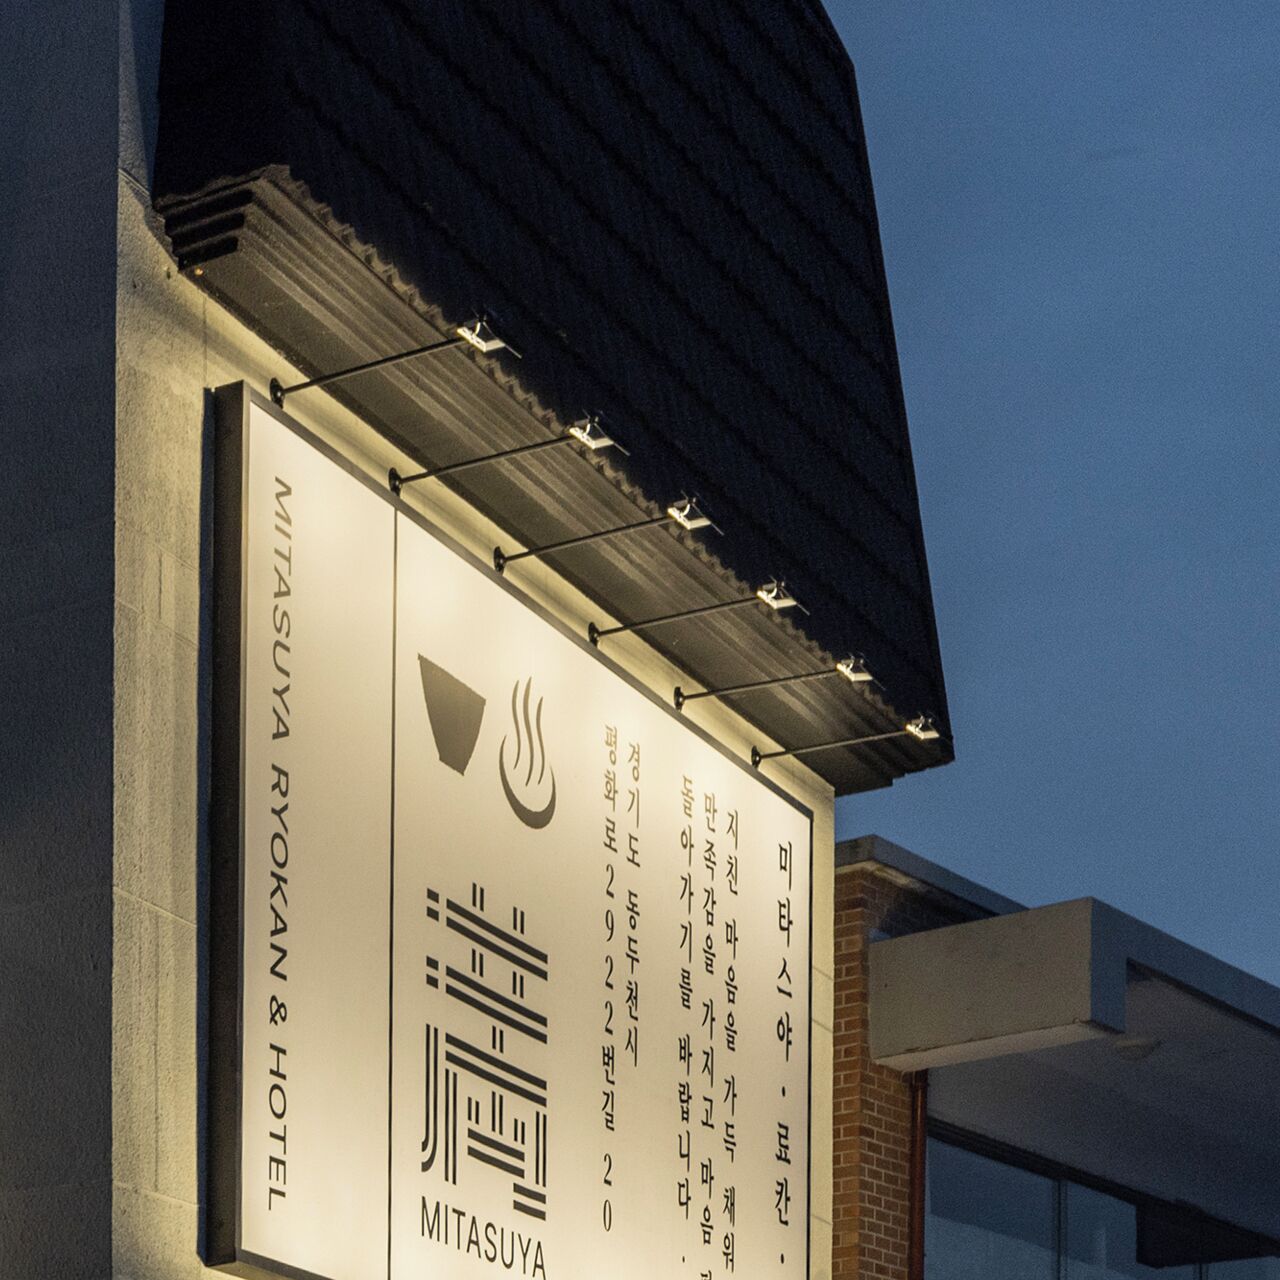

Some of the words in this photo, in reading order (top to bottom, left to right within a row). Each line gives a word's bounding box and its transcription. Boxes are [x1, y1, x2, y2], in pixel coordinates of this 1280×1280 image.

[271, 475, 293, 741] MITASUYA
[625, 743, 641, 868] 경기도
[725, 809, 739, 897] 지친
[269, 763, 290, 982] RYOKAN
[678, 775, 695, 1011] 돌아가기를
[702, 794, 718, 976] 만족감을
[269, 994, 288, 1027] &
[624, 889, 641, 1068] 동두천시
[723, 918, 739, 1053] 마음을
[268, 1042, 288, 1211] HOTEL
[700, 998, 716, 1130] 가지고
[722, 1074, 738, 1164] 가득
[602, 1153, 613, 1232] 20
[699, 1157, 715, 1245] 마음
[721, 1185, 736, 1273] 채워
